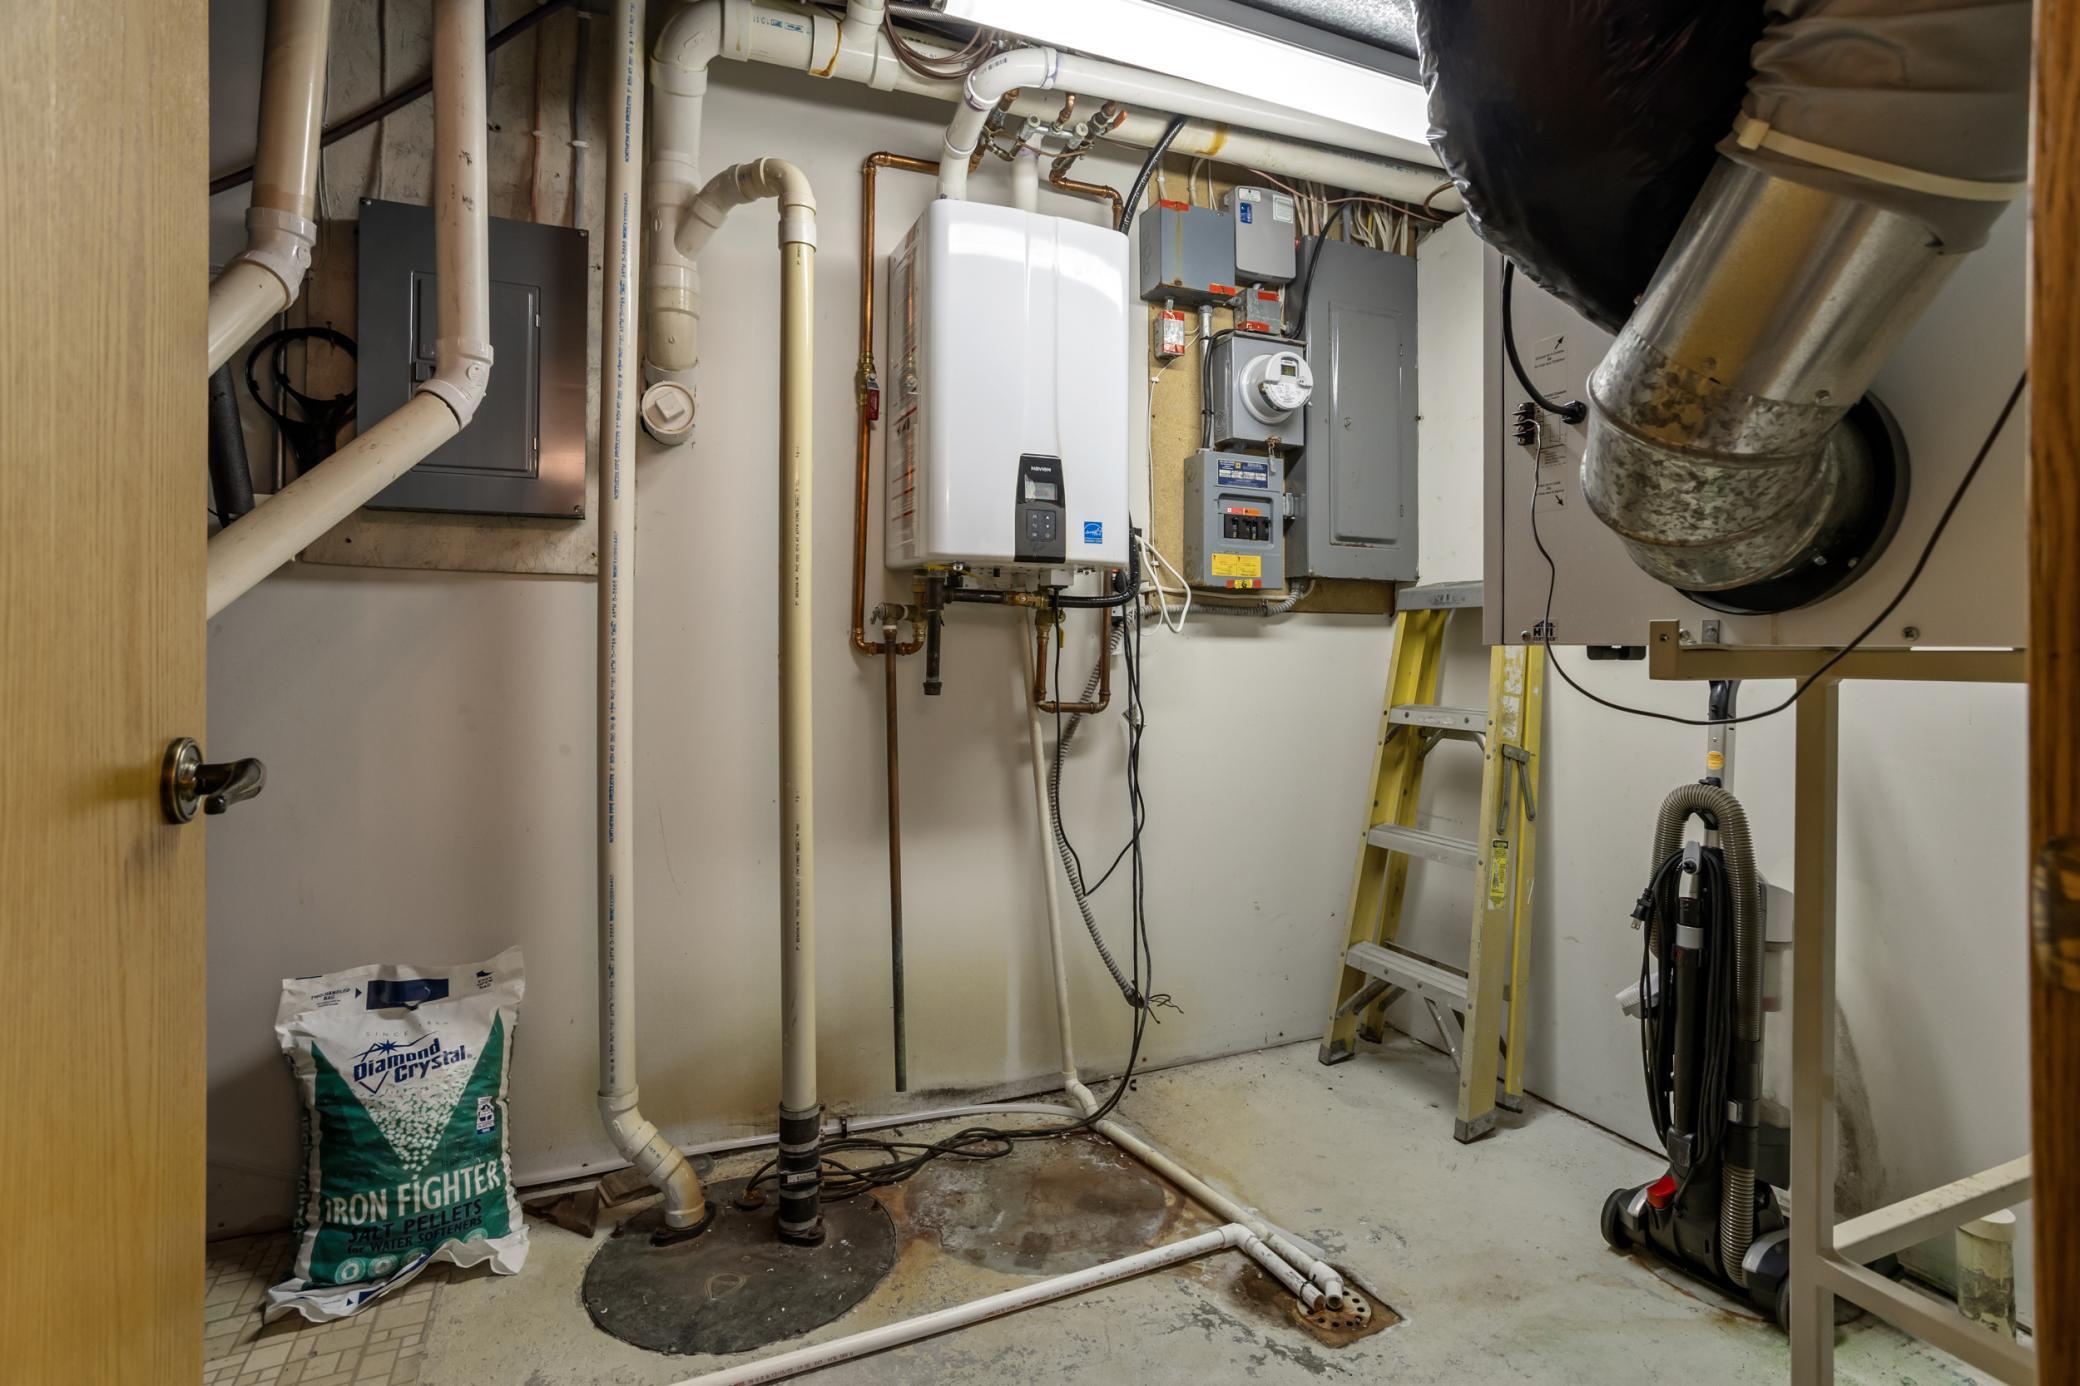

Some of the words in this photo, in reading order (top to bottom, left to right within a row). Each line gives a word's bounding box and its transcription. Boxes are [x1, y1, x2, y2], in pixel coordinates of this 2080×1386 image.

[365, 1030, 409, 1038] SINCE
[353, 1037, 441, 1082] Diamond
[394, 1045, 467, 1083] Crystal
[325, 1188, 388, 1226] IRON
[398, 1159, 501, 1217] FIGHTER
[347, 1242, 364, 1254] for
[369, 1236, 413, 1252] WATER
[418, 1215, 483, 1244] SOFTENERS
[348, 1222, 395, 1244] SALT
[403, 1198, 483, 1235] PELLETS
